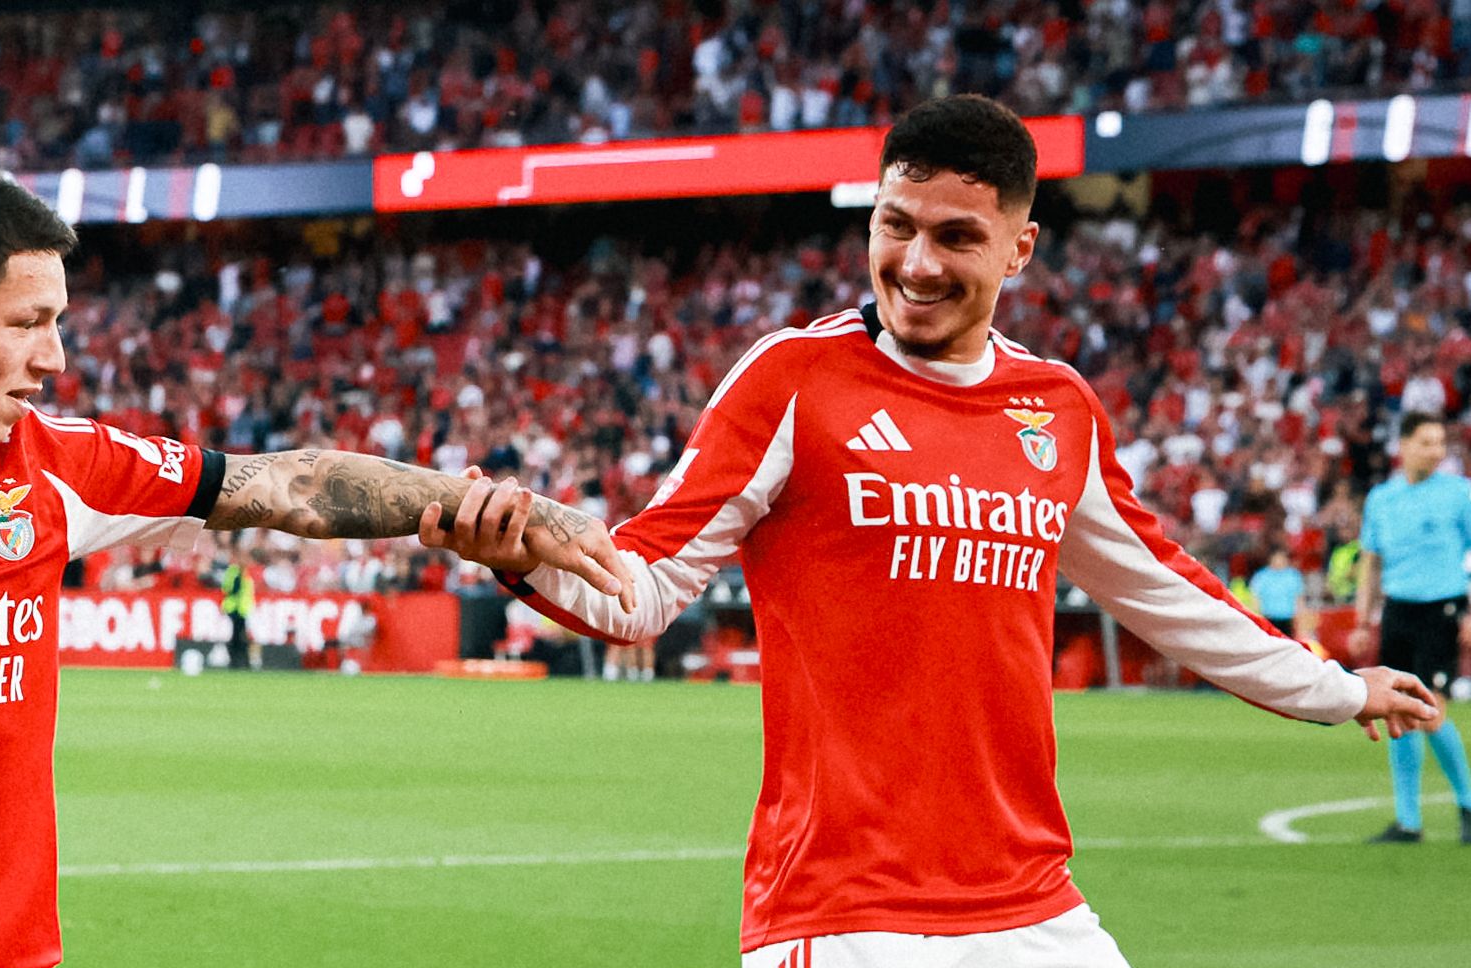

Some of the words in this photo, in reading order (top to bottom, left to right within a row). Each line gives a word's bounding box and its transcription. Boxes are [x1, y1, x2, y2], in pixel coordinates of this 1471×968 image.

[843, 472, 1068, 543] Emirates
[890, 535, 946, 580] FLY
[953, 538, 1045, 592] BETTER
